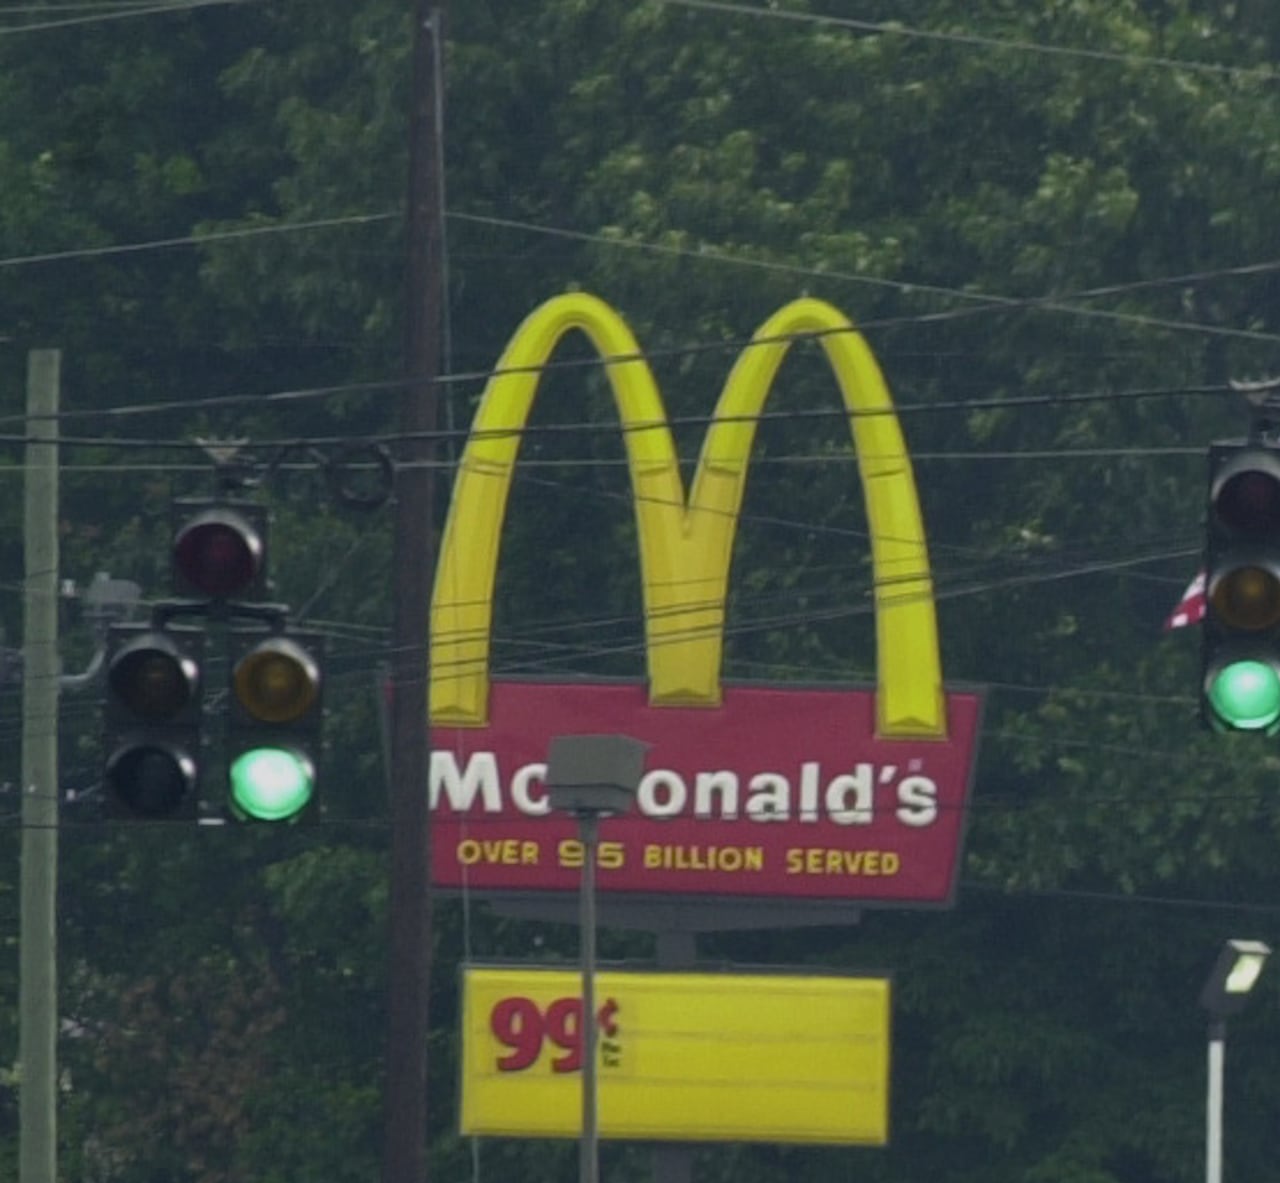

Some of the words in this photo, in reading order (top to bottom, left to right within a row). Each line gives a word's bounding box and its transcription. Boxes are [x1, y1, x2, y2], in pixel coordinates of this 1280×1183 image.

[428, 751, 938, 827] Mconald's
[456, 839, 539, 866] OVER
[557, 841, 626, 868] 95
[642, 844, 764, 872] BILLION
[785, 847, 900, 876] SERVED
